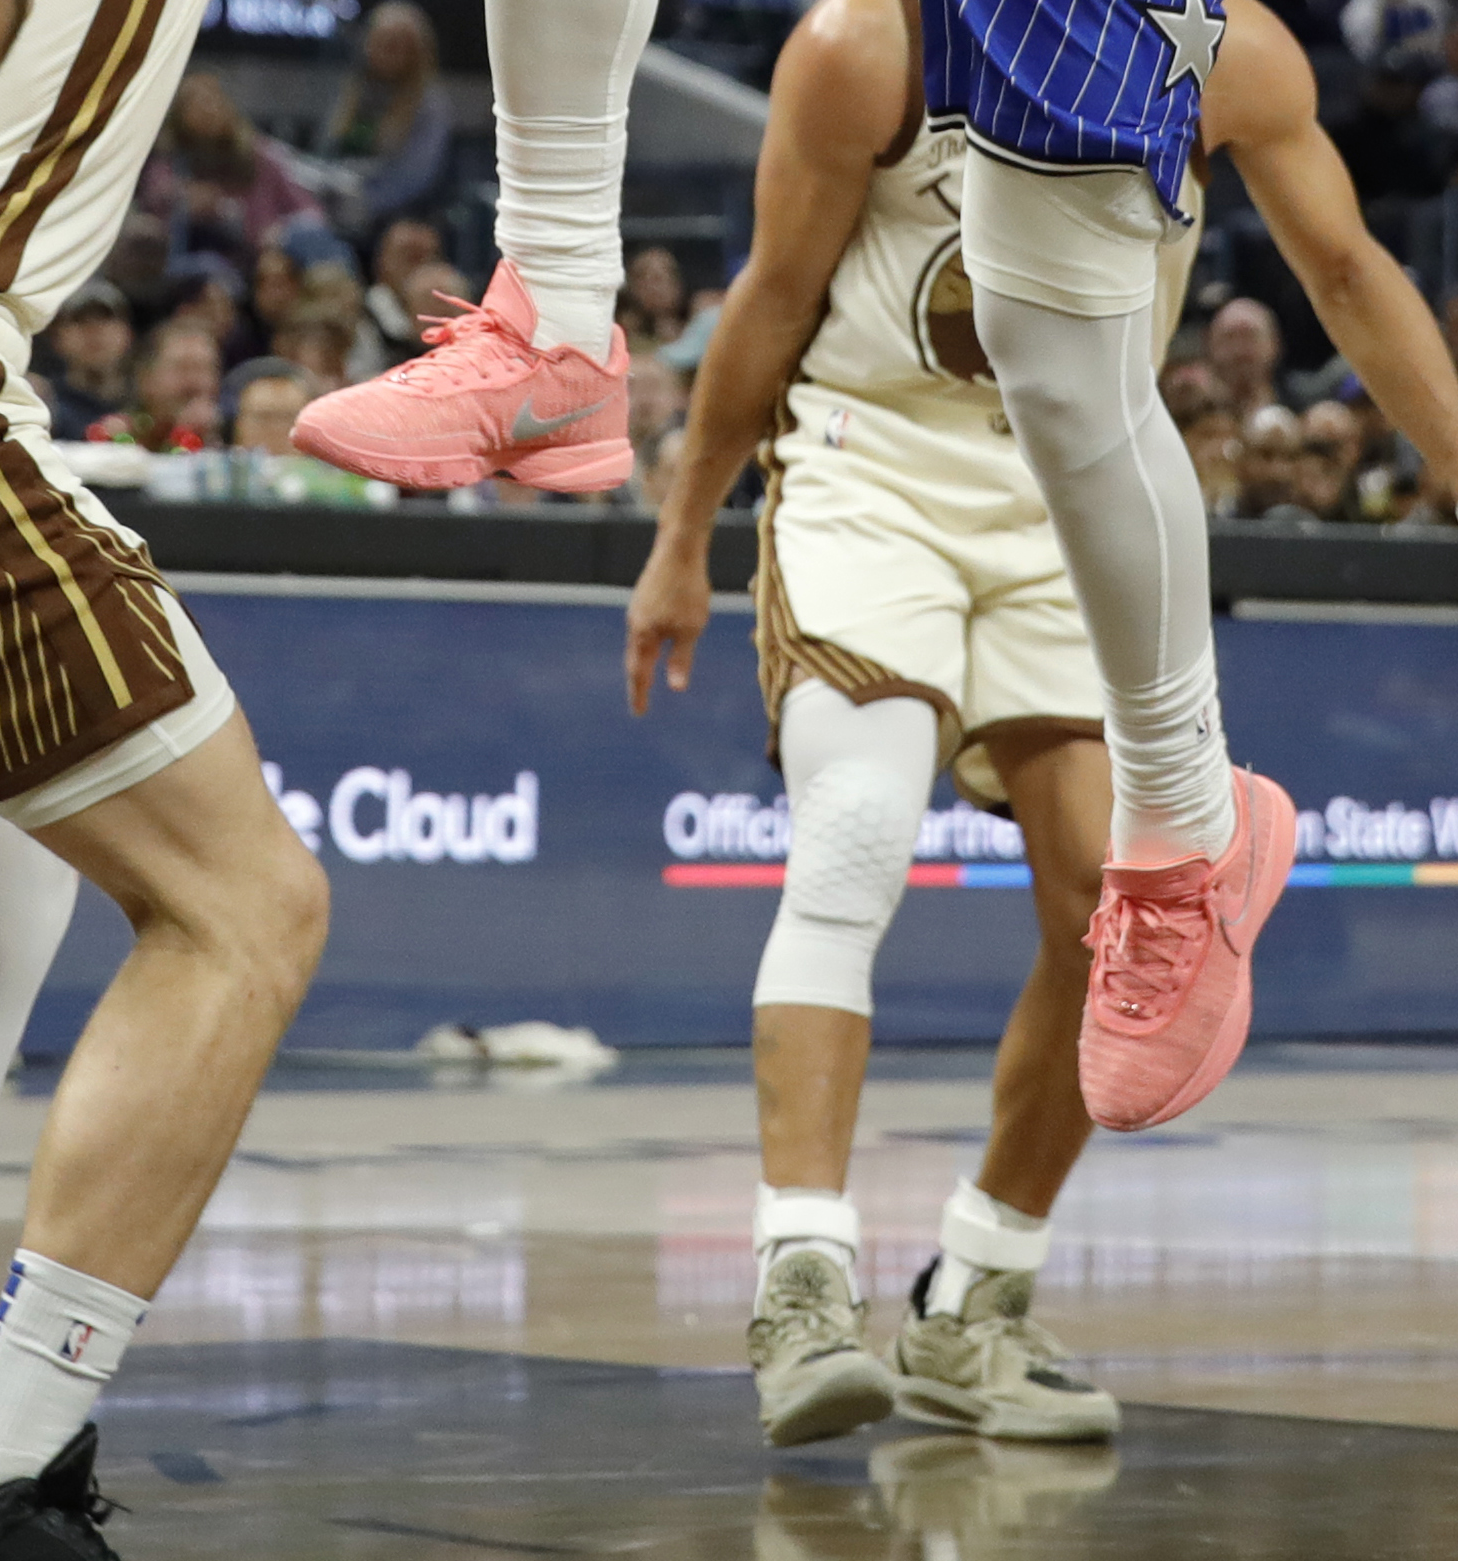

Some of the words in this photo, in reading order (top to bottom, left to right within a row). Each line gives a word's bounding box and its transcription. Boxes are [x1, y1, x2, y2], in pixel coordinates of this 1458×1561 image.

[328, 765, 540, 864] Cloud
[662, 791, 791, 859] Offici
[1324, 796, 1431, 860] State
